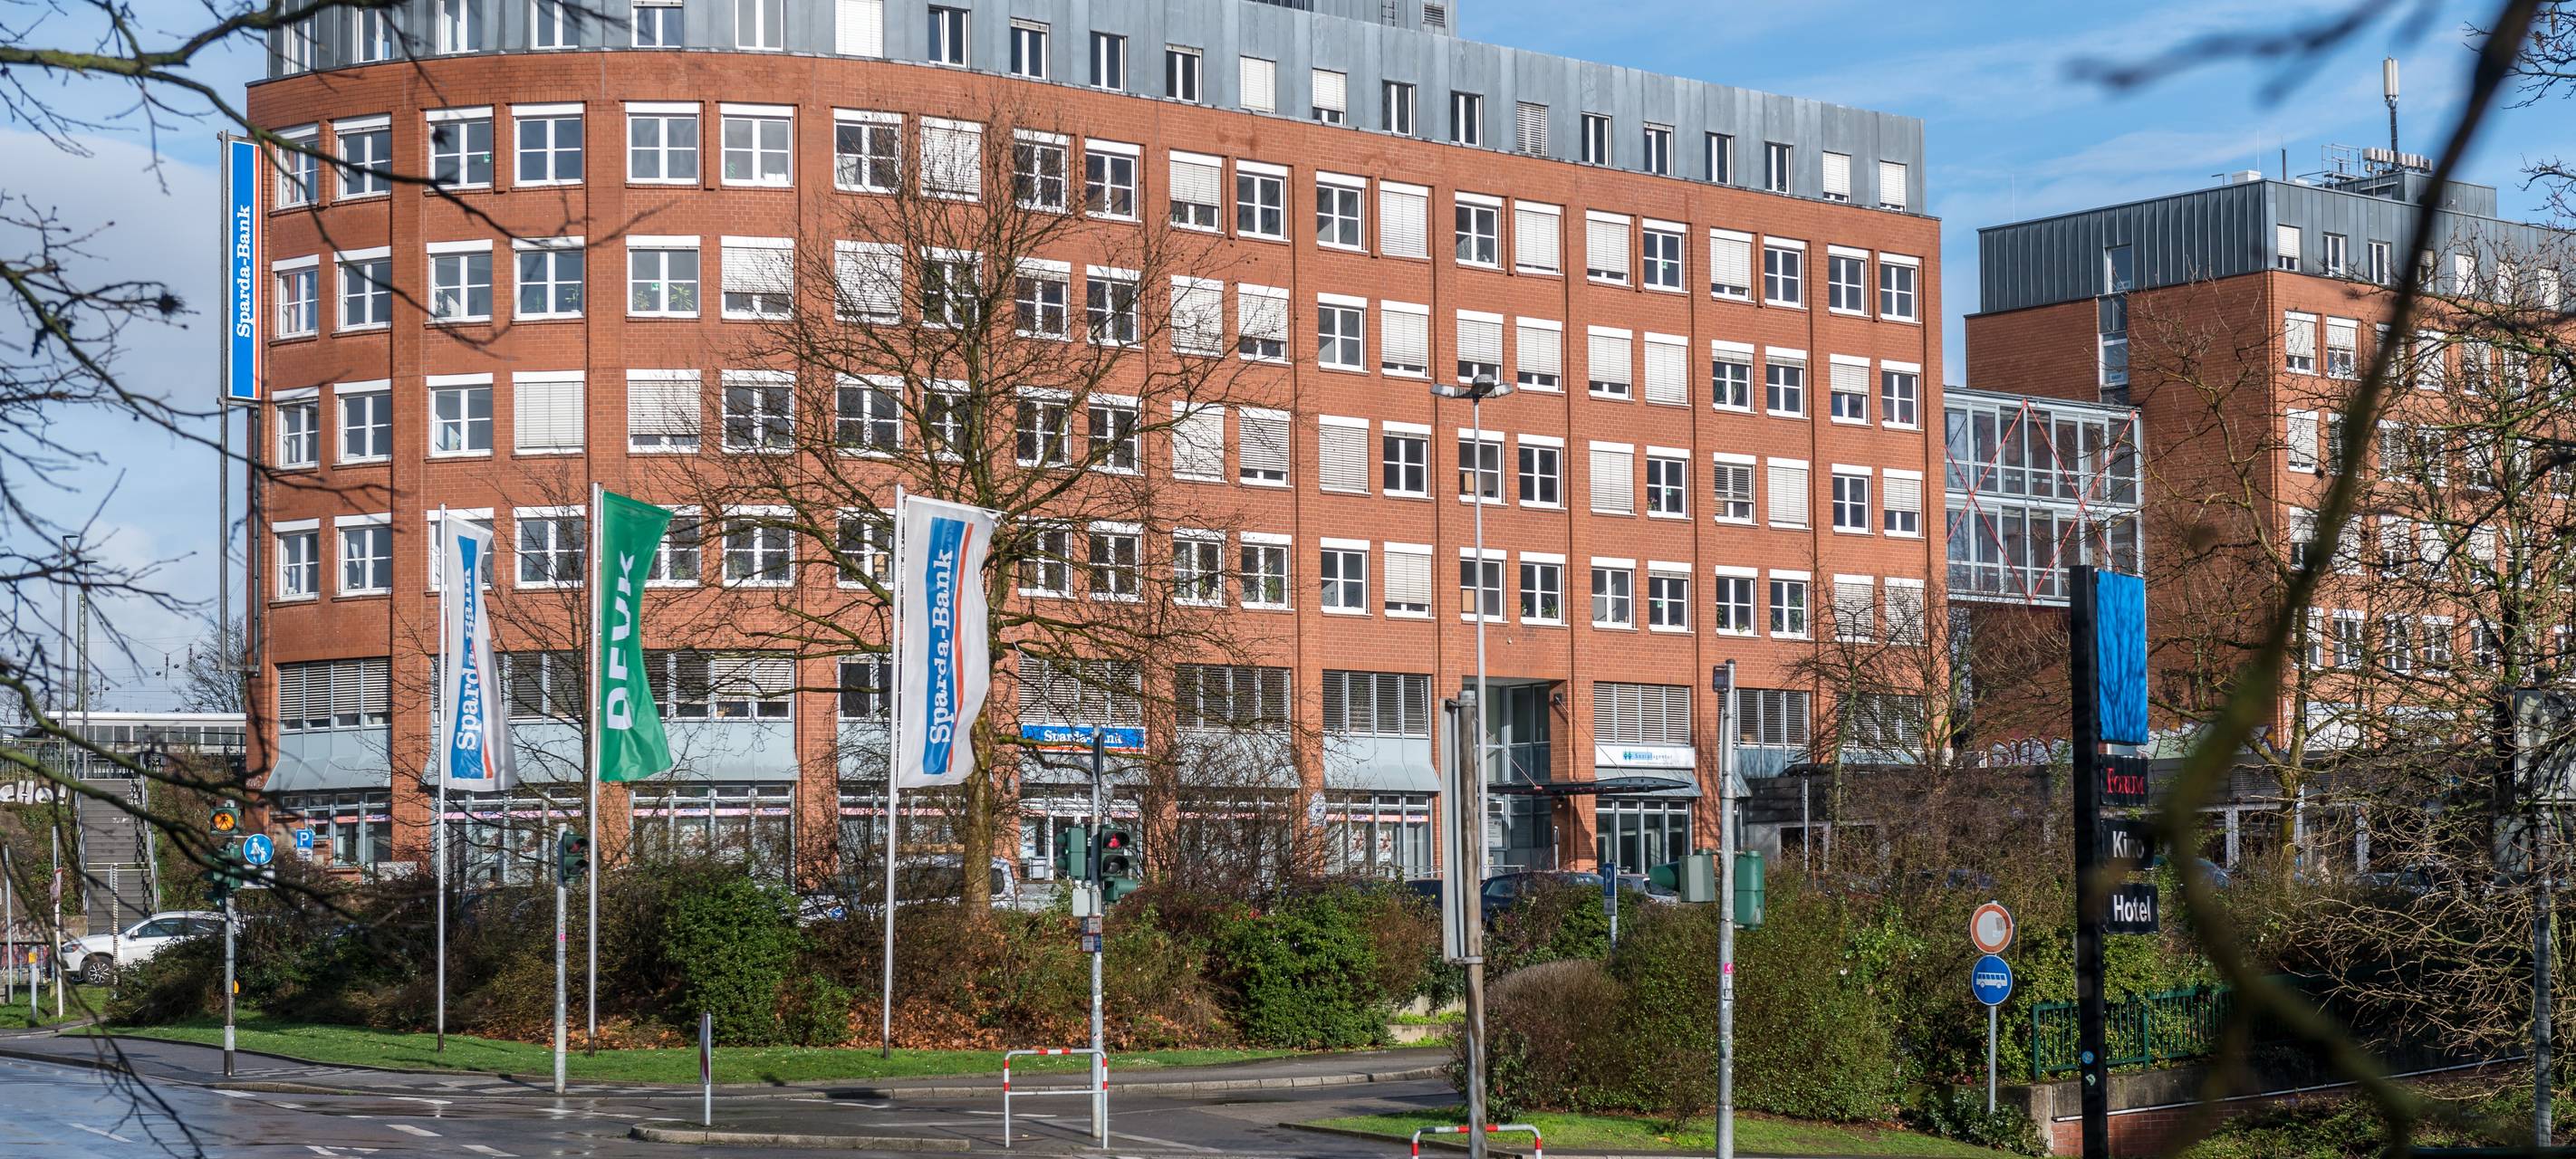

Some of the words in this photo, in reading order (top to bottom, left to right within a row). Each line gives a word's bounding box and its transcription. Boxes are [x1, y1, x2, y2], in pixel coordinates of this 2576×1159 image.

[236, 205, 254, 338] Sparda-Bank
[929, 549, 955, 743] Sparda-Bank
[300, 832, 308, 846] P
[1605, 867, 1612, 893] P
[2113, 895, 2151, 923] Hotel
